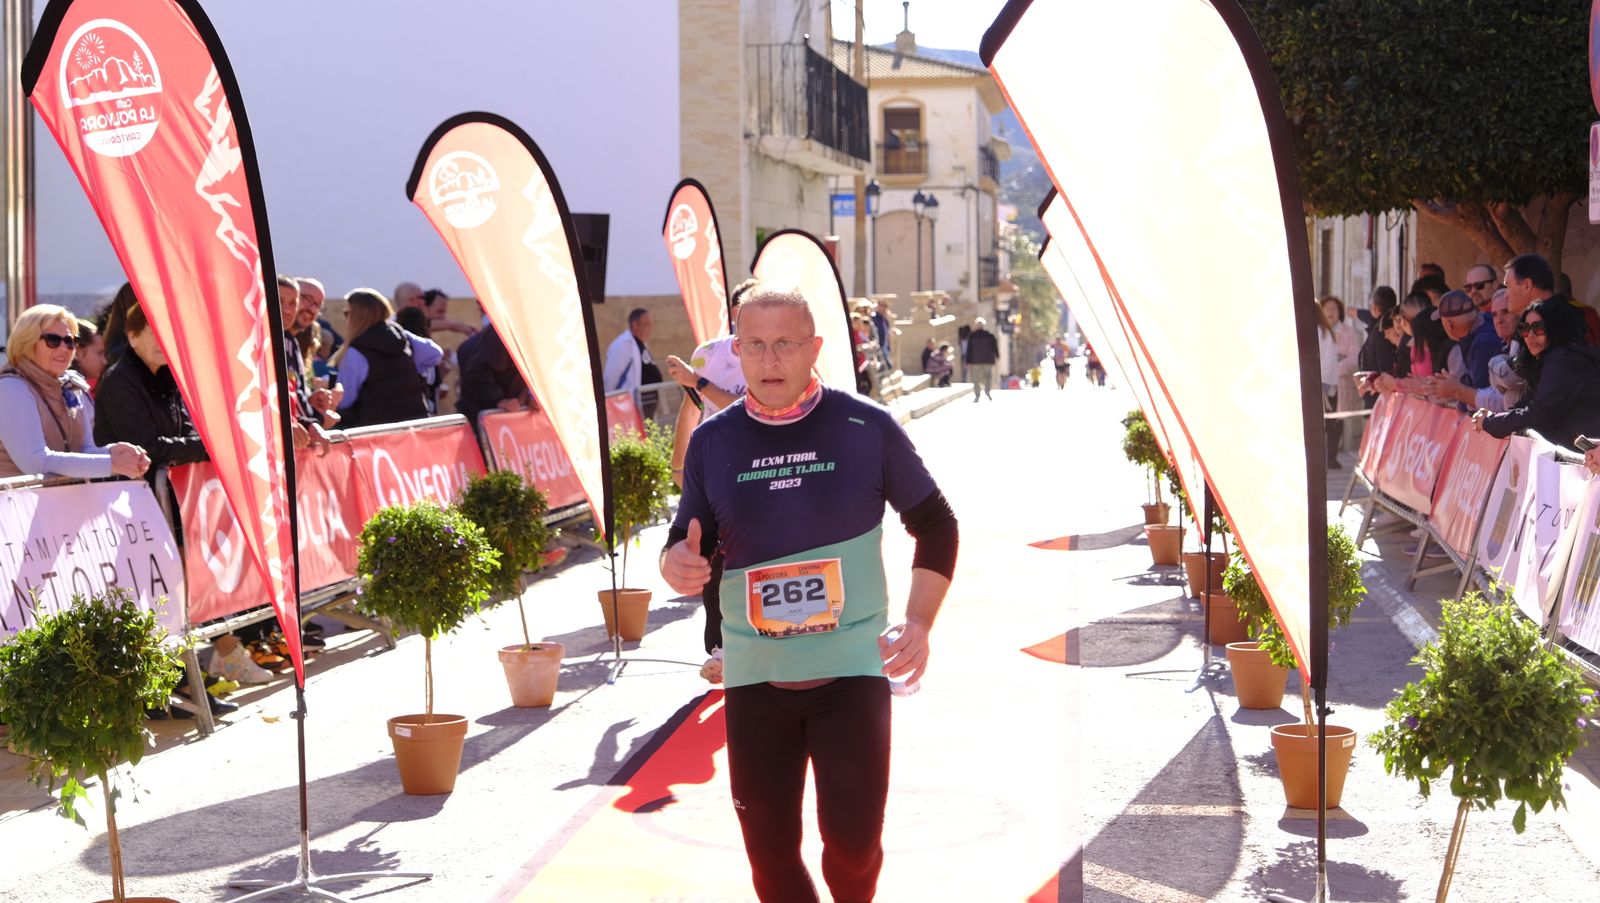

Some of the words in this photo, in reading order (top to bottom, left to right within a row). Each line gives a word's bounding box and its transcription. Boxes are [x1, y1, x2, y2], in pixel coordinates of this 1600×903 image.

[761, 455, 784, 467] CXM
[786, 451, 818, 463] TRAIL
[736, 468, 777, 483] CIUDAD
[778, 466, 793, 477] DE
[795, 462, 836, 475] TIJOLA
[769, 478, 802, 490] 2023
[0, 527, 117, 567] TAMIENTO
[126, 520, 154, 545] DE
[761, 578, 826, 608] 262
